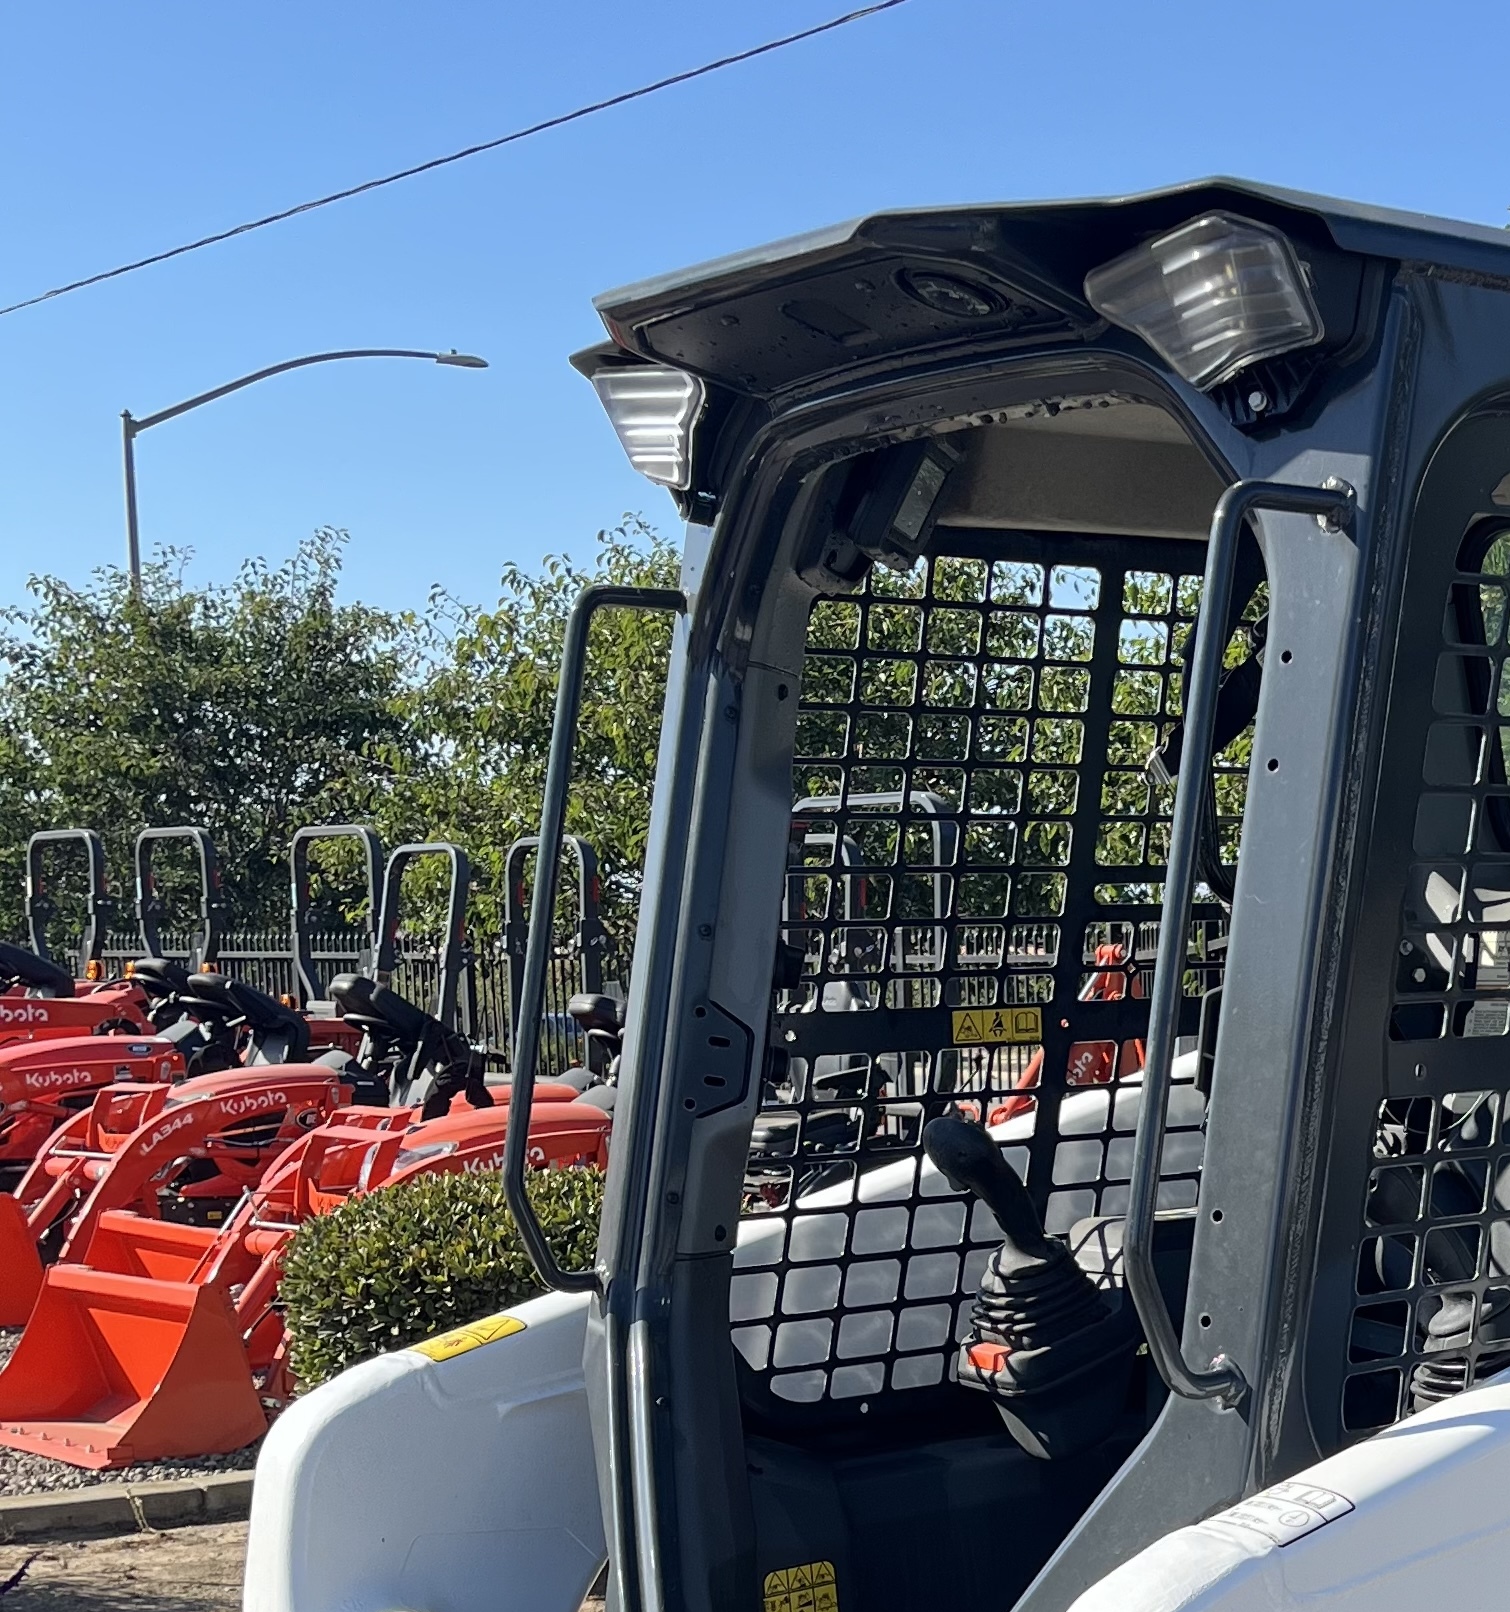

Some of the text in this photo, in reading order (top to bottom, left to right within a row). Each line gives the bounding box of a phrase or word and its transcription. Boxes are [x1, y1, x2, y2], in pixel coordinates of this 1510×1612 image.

[25, 1069, 92, 1088] Kubota
[220, 1090, 287, 1115] Kubota
[140, 1112, 194, 1156] LA344
